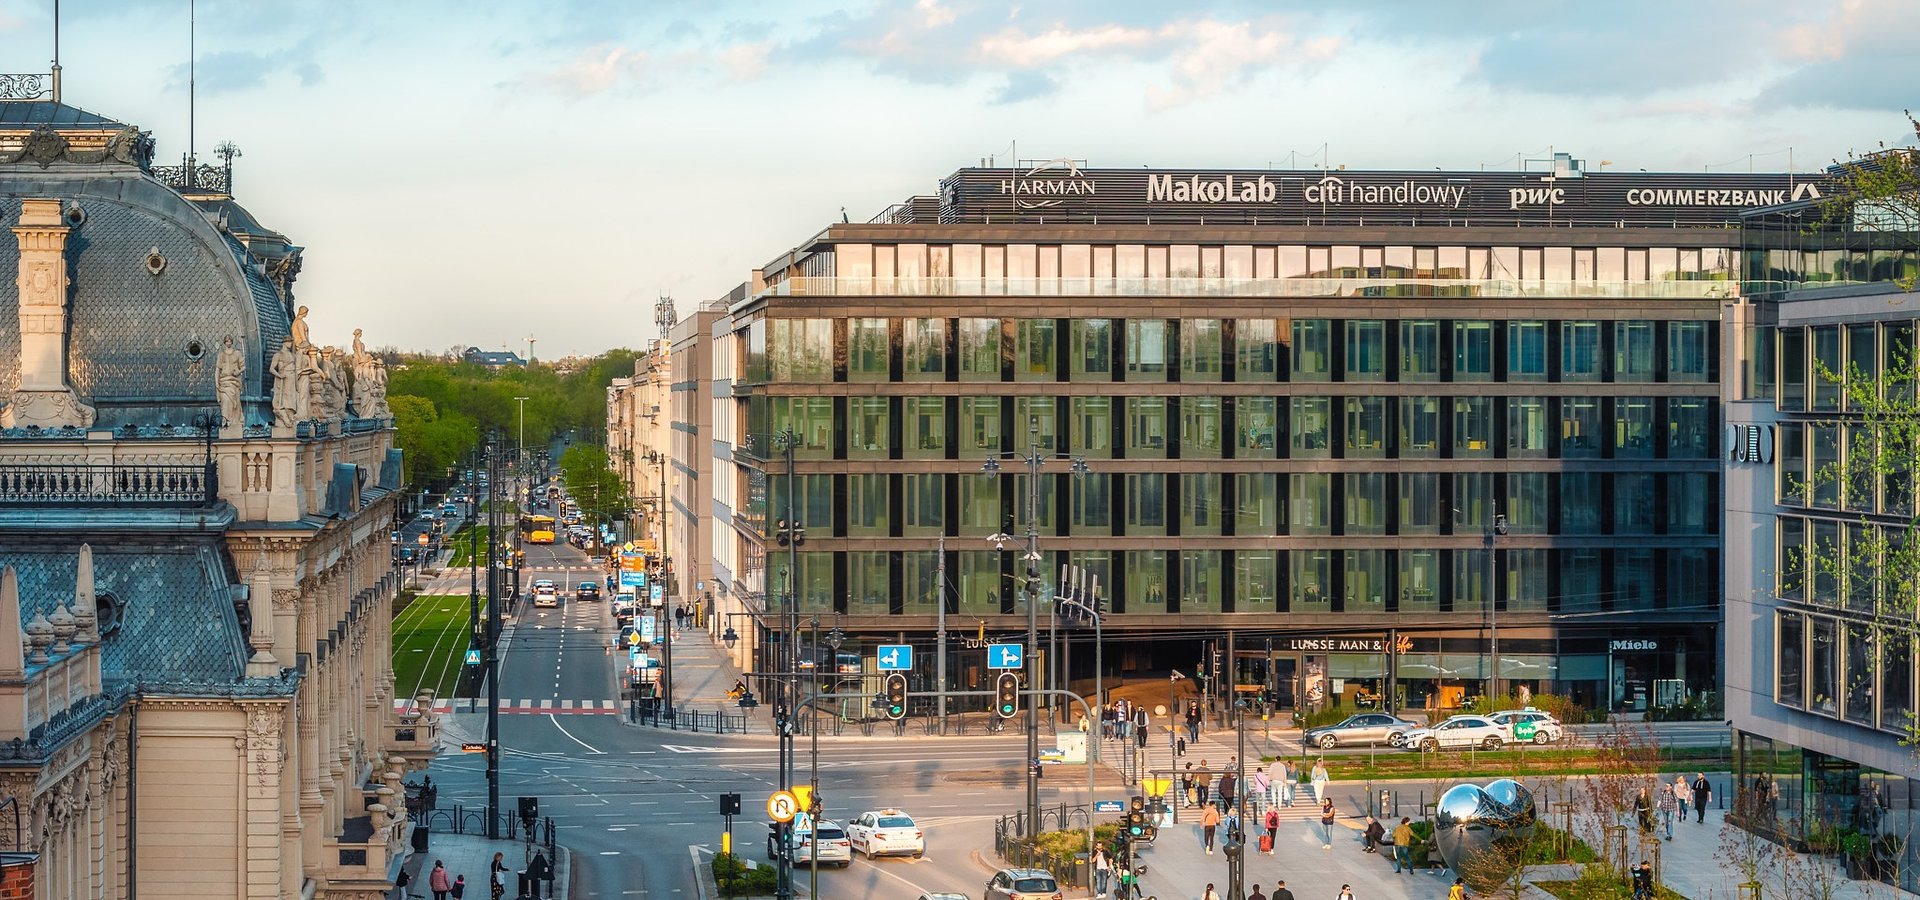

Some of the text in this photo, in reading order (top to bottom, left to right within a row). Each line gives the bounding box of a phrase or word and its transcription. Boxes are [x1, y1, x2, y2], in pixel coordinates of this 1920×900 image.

[1001, 180, 1095, 195] HARMAN
[1148, 174, 1277, 202] MakoLab
[1305, 177, 1465, 208] citi handlowy
[1626, 189, 1786, 206] COMMERZBANK
[1509, 187, 1565, 210] pwc
[1727, 424, 1773, 464] PURO
[1339, 640, 1369, 650] MAN
[1373, 641, 1382, 650] &
[1612, 640, 1657, 650] Miele
